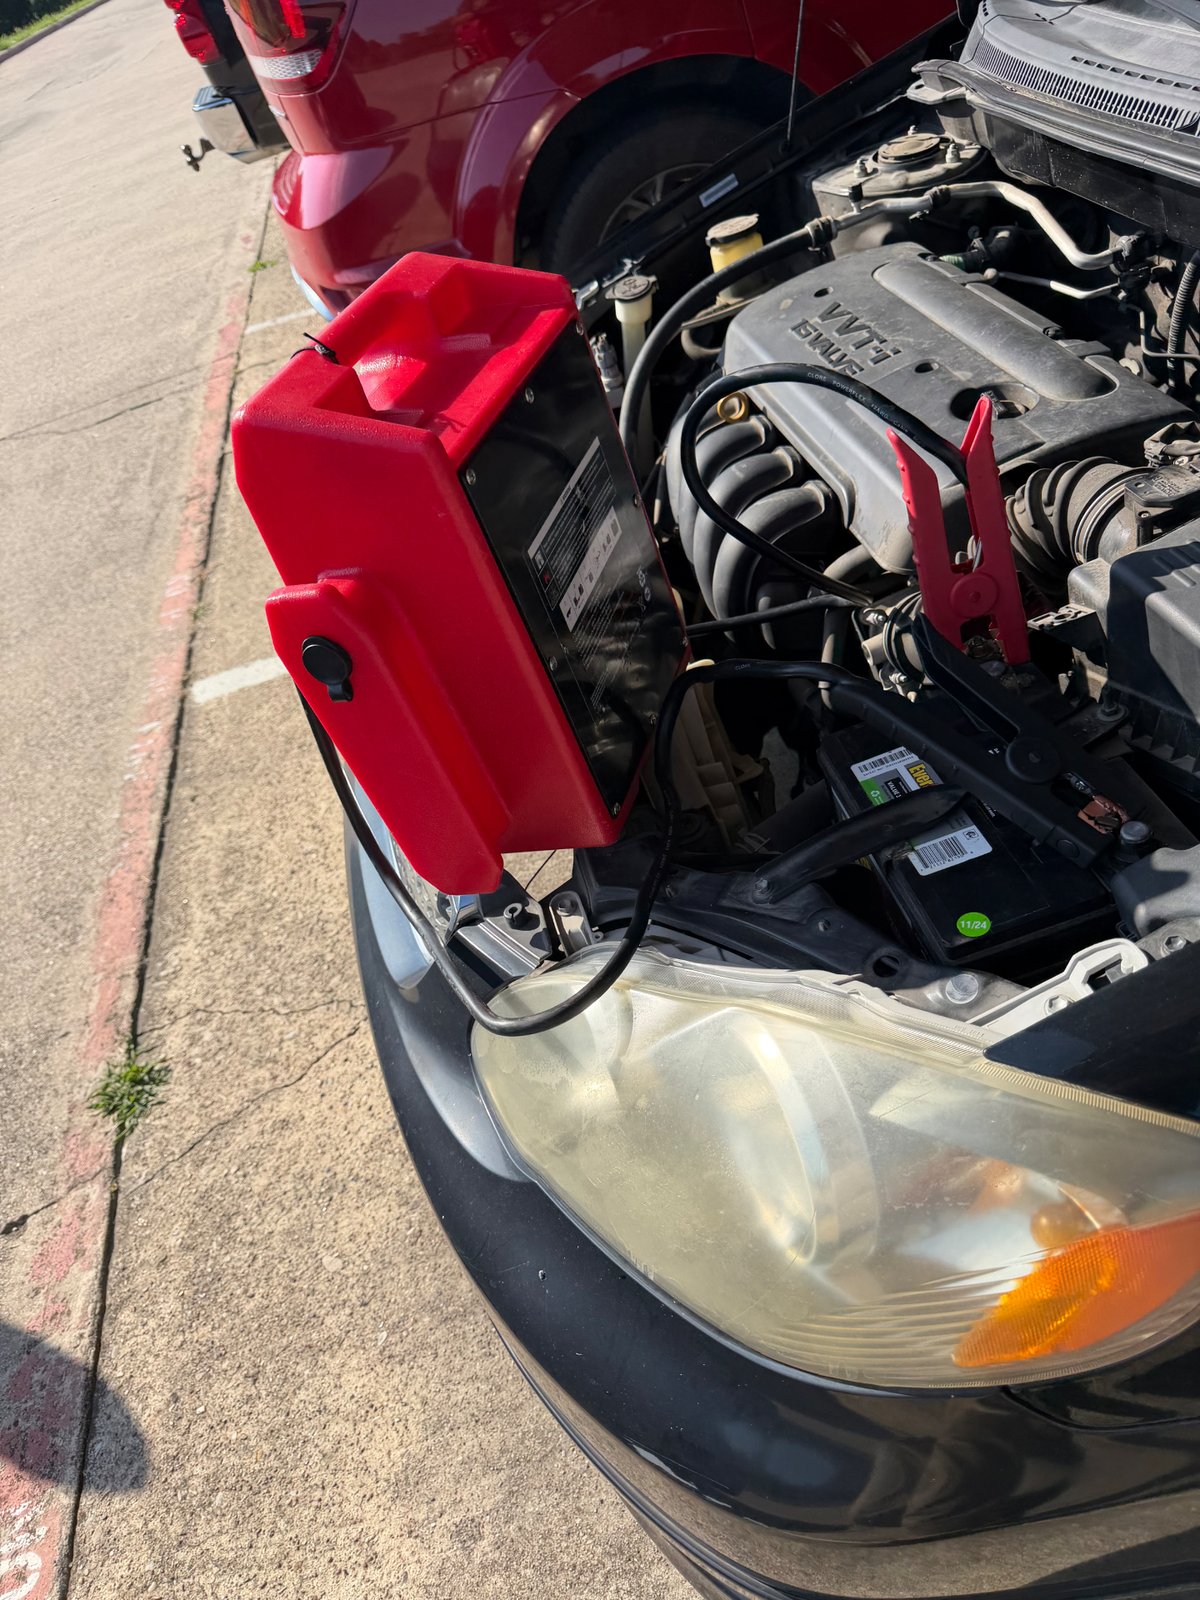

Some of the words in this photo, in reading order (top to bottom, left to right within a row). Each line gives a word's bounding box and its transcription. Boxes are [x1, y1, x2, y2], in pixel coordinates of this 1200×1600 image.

[807, 371, 827, 382] CLORE
[832, 380, 867, 402] POWERFLEX
[960, 920, 987, 929] 11/24
